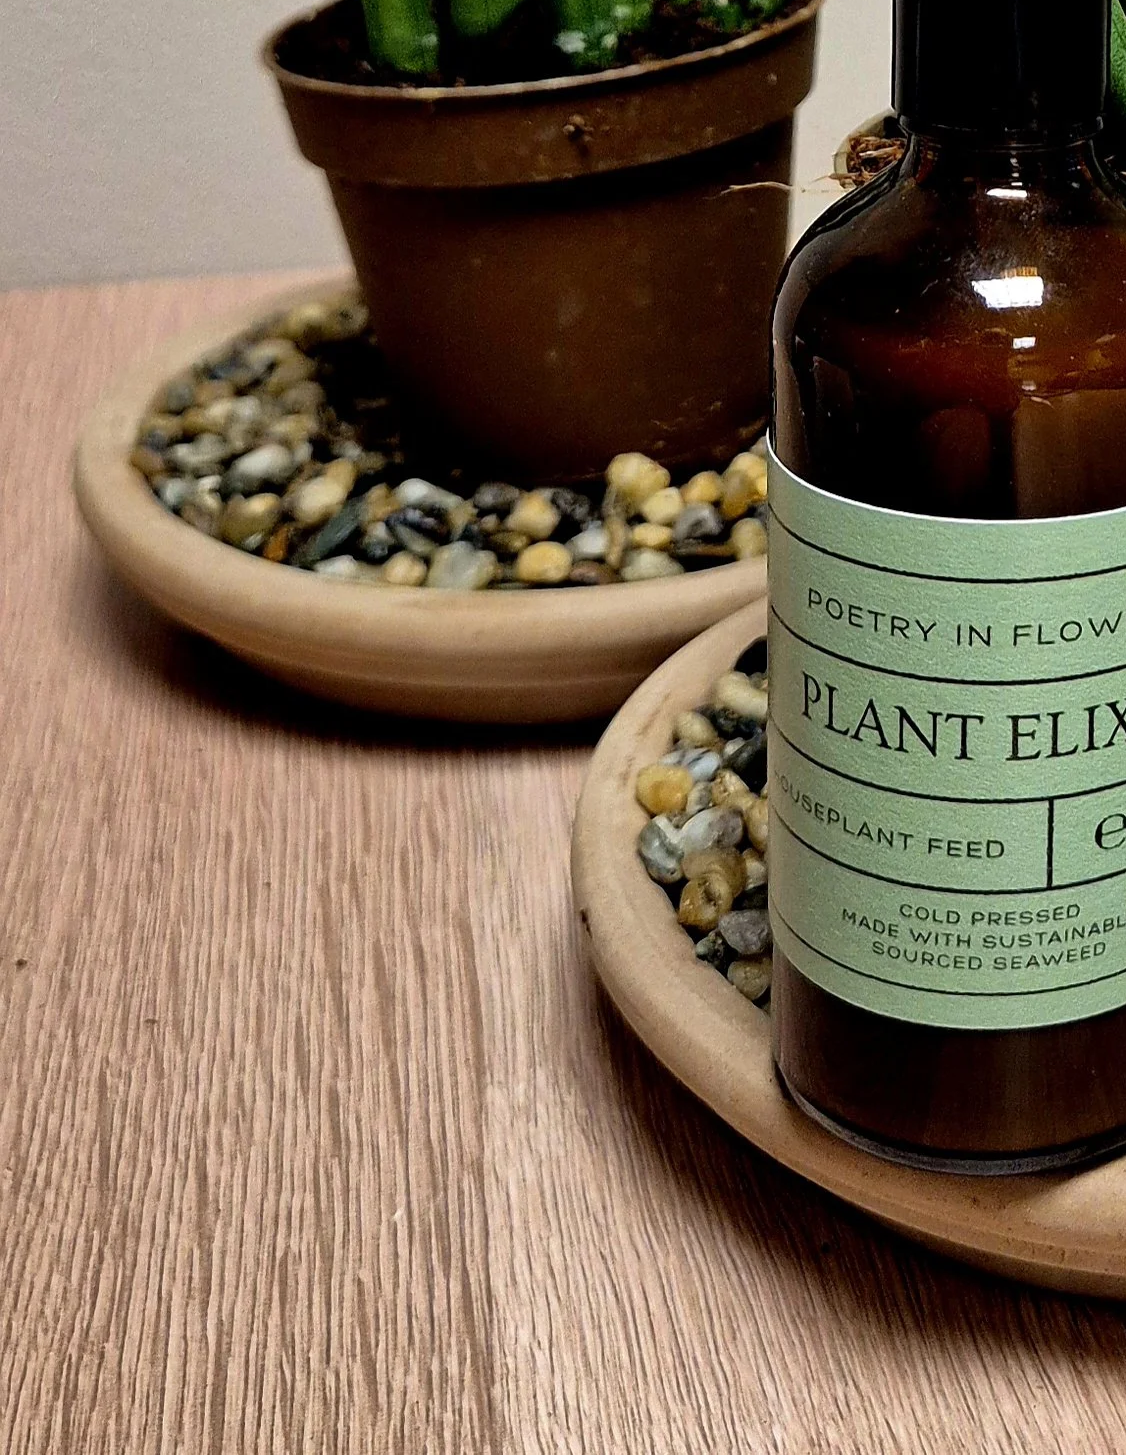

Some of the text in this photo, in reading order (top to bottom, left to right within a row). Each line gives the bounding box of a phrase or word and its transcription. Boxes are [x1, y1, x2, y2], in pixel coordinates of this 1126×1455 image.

[807, 588, 937, 641] POETRY
[956, 625, 991, 646] IN
[801, 671, 985, 761] PLANT
[927, 839, 1005, 859] FEED
[842, 908, 900, 938] MADE
[910, 931, 971, 949] WITH
[899, 903, 1081, 926] COLD PRESSED
[872, 941, 1106, 971] SOURCED SEAWEED
